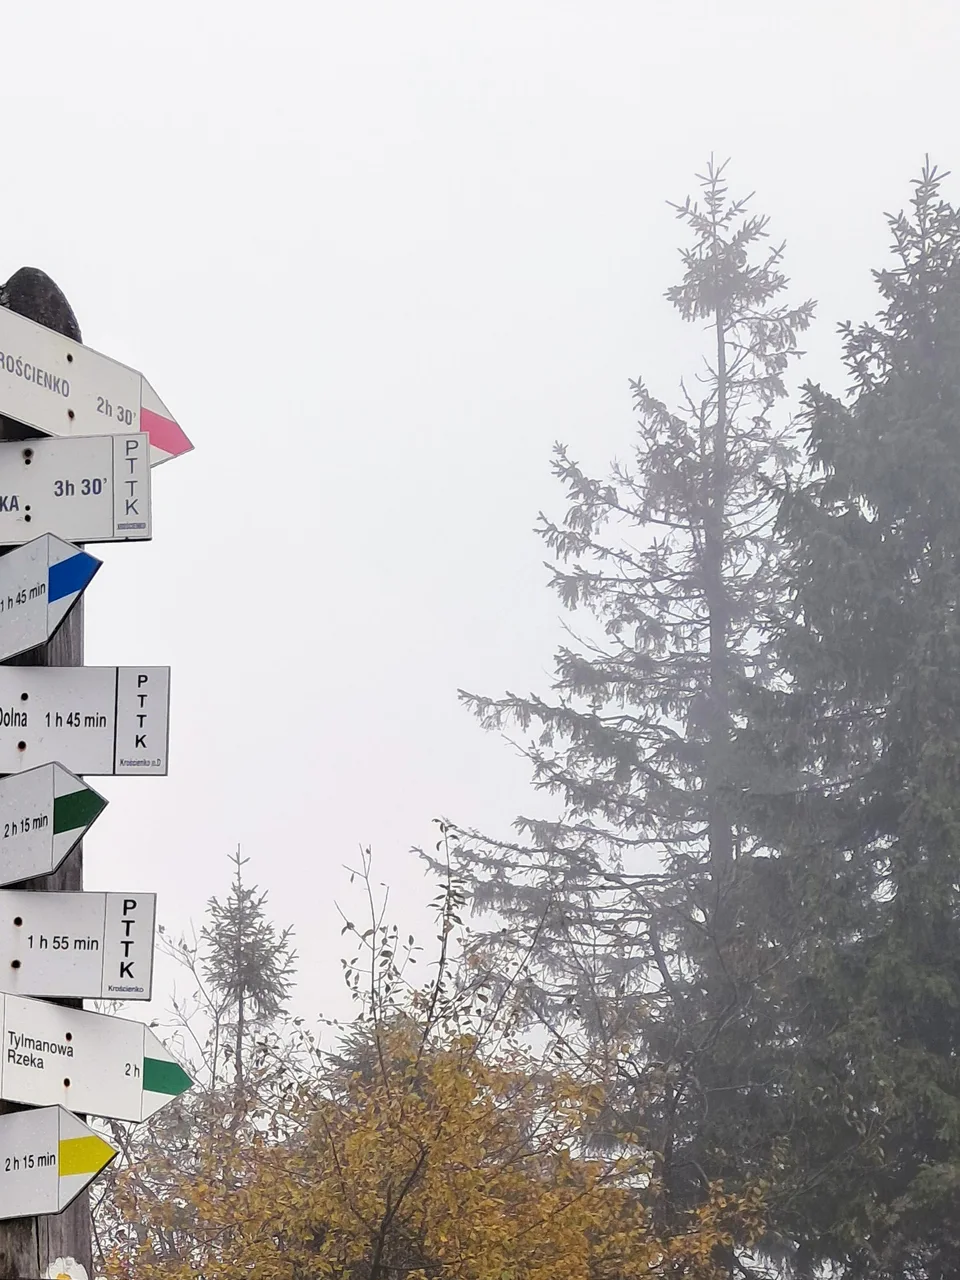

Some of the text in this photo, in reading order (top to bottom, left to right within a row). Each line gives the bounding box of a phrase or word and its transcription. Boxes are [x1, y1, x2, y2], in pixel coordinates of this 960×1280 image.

[96, 396, 113, 417] 2h
[53, 479, 75, 497] 3h
[0, 582, 46, 612] 1 h 45 min
[45, 712, 106, 728] 1 h 45 min
[4, 813, 48, 838] 2 h 15 min
[28, 936, 99, 951] 1 h 55 min
[8, 1031, 74, 1058] Tylmanowa
[7, 1049, 44, 1070] Rzeka
[125, 1063, 140, 1079] 2 h
[5, 1152, 56, 1172] 2 h 15 min
